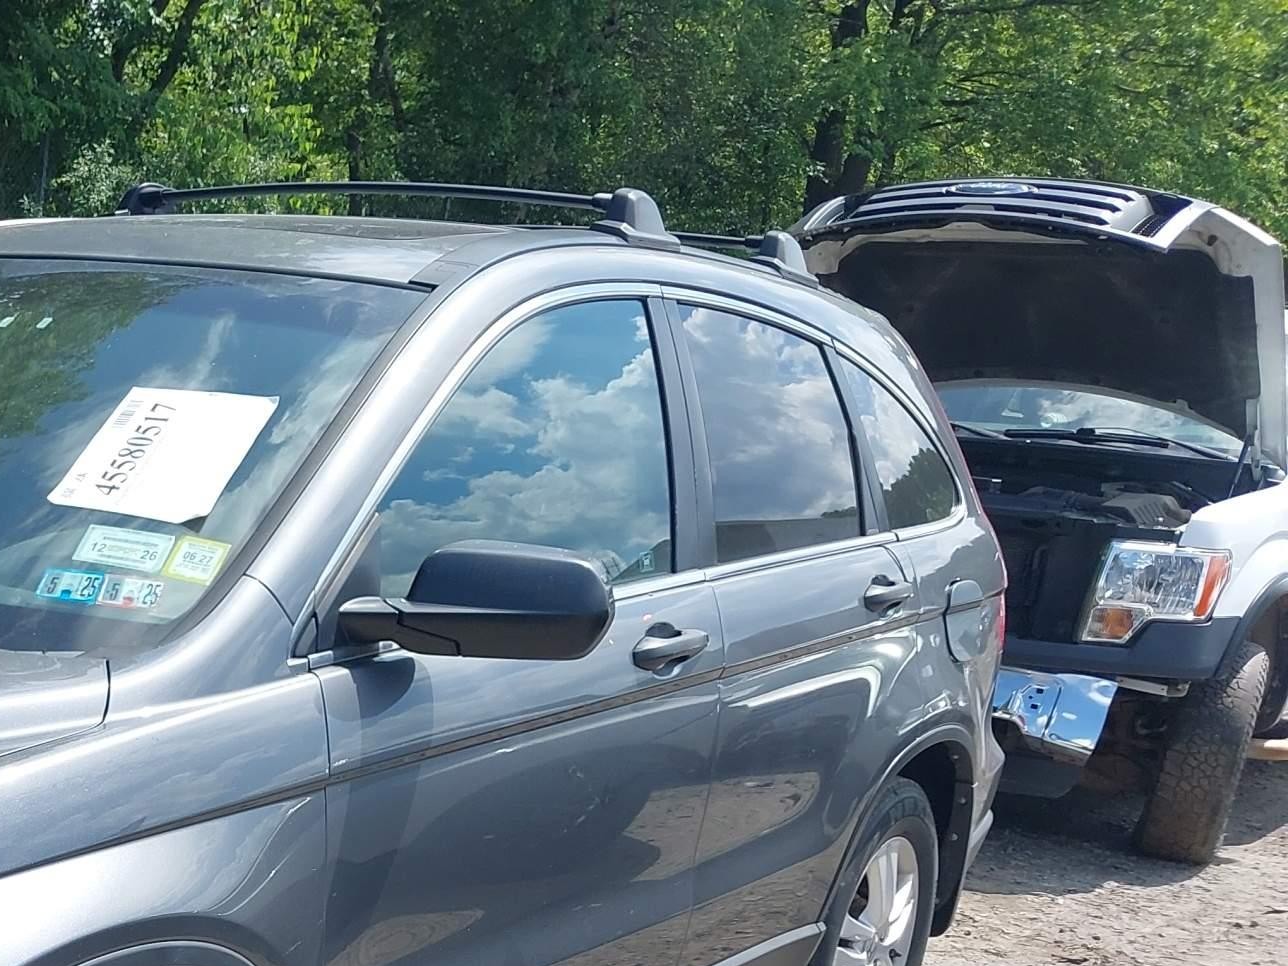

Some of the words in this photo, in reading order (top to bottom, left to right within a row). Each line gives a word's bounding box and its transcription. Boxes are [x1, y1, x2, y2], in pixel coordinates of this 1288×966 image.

[95, 403, 176, 495] 45580517
[90, 541, 107, 553] 12
[139, 549, 159, 561] 26
[46, 576, 59, 594] 5
[79, 576, 101, 597] 25
[141, 583, 162, 604] 25
